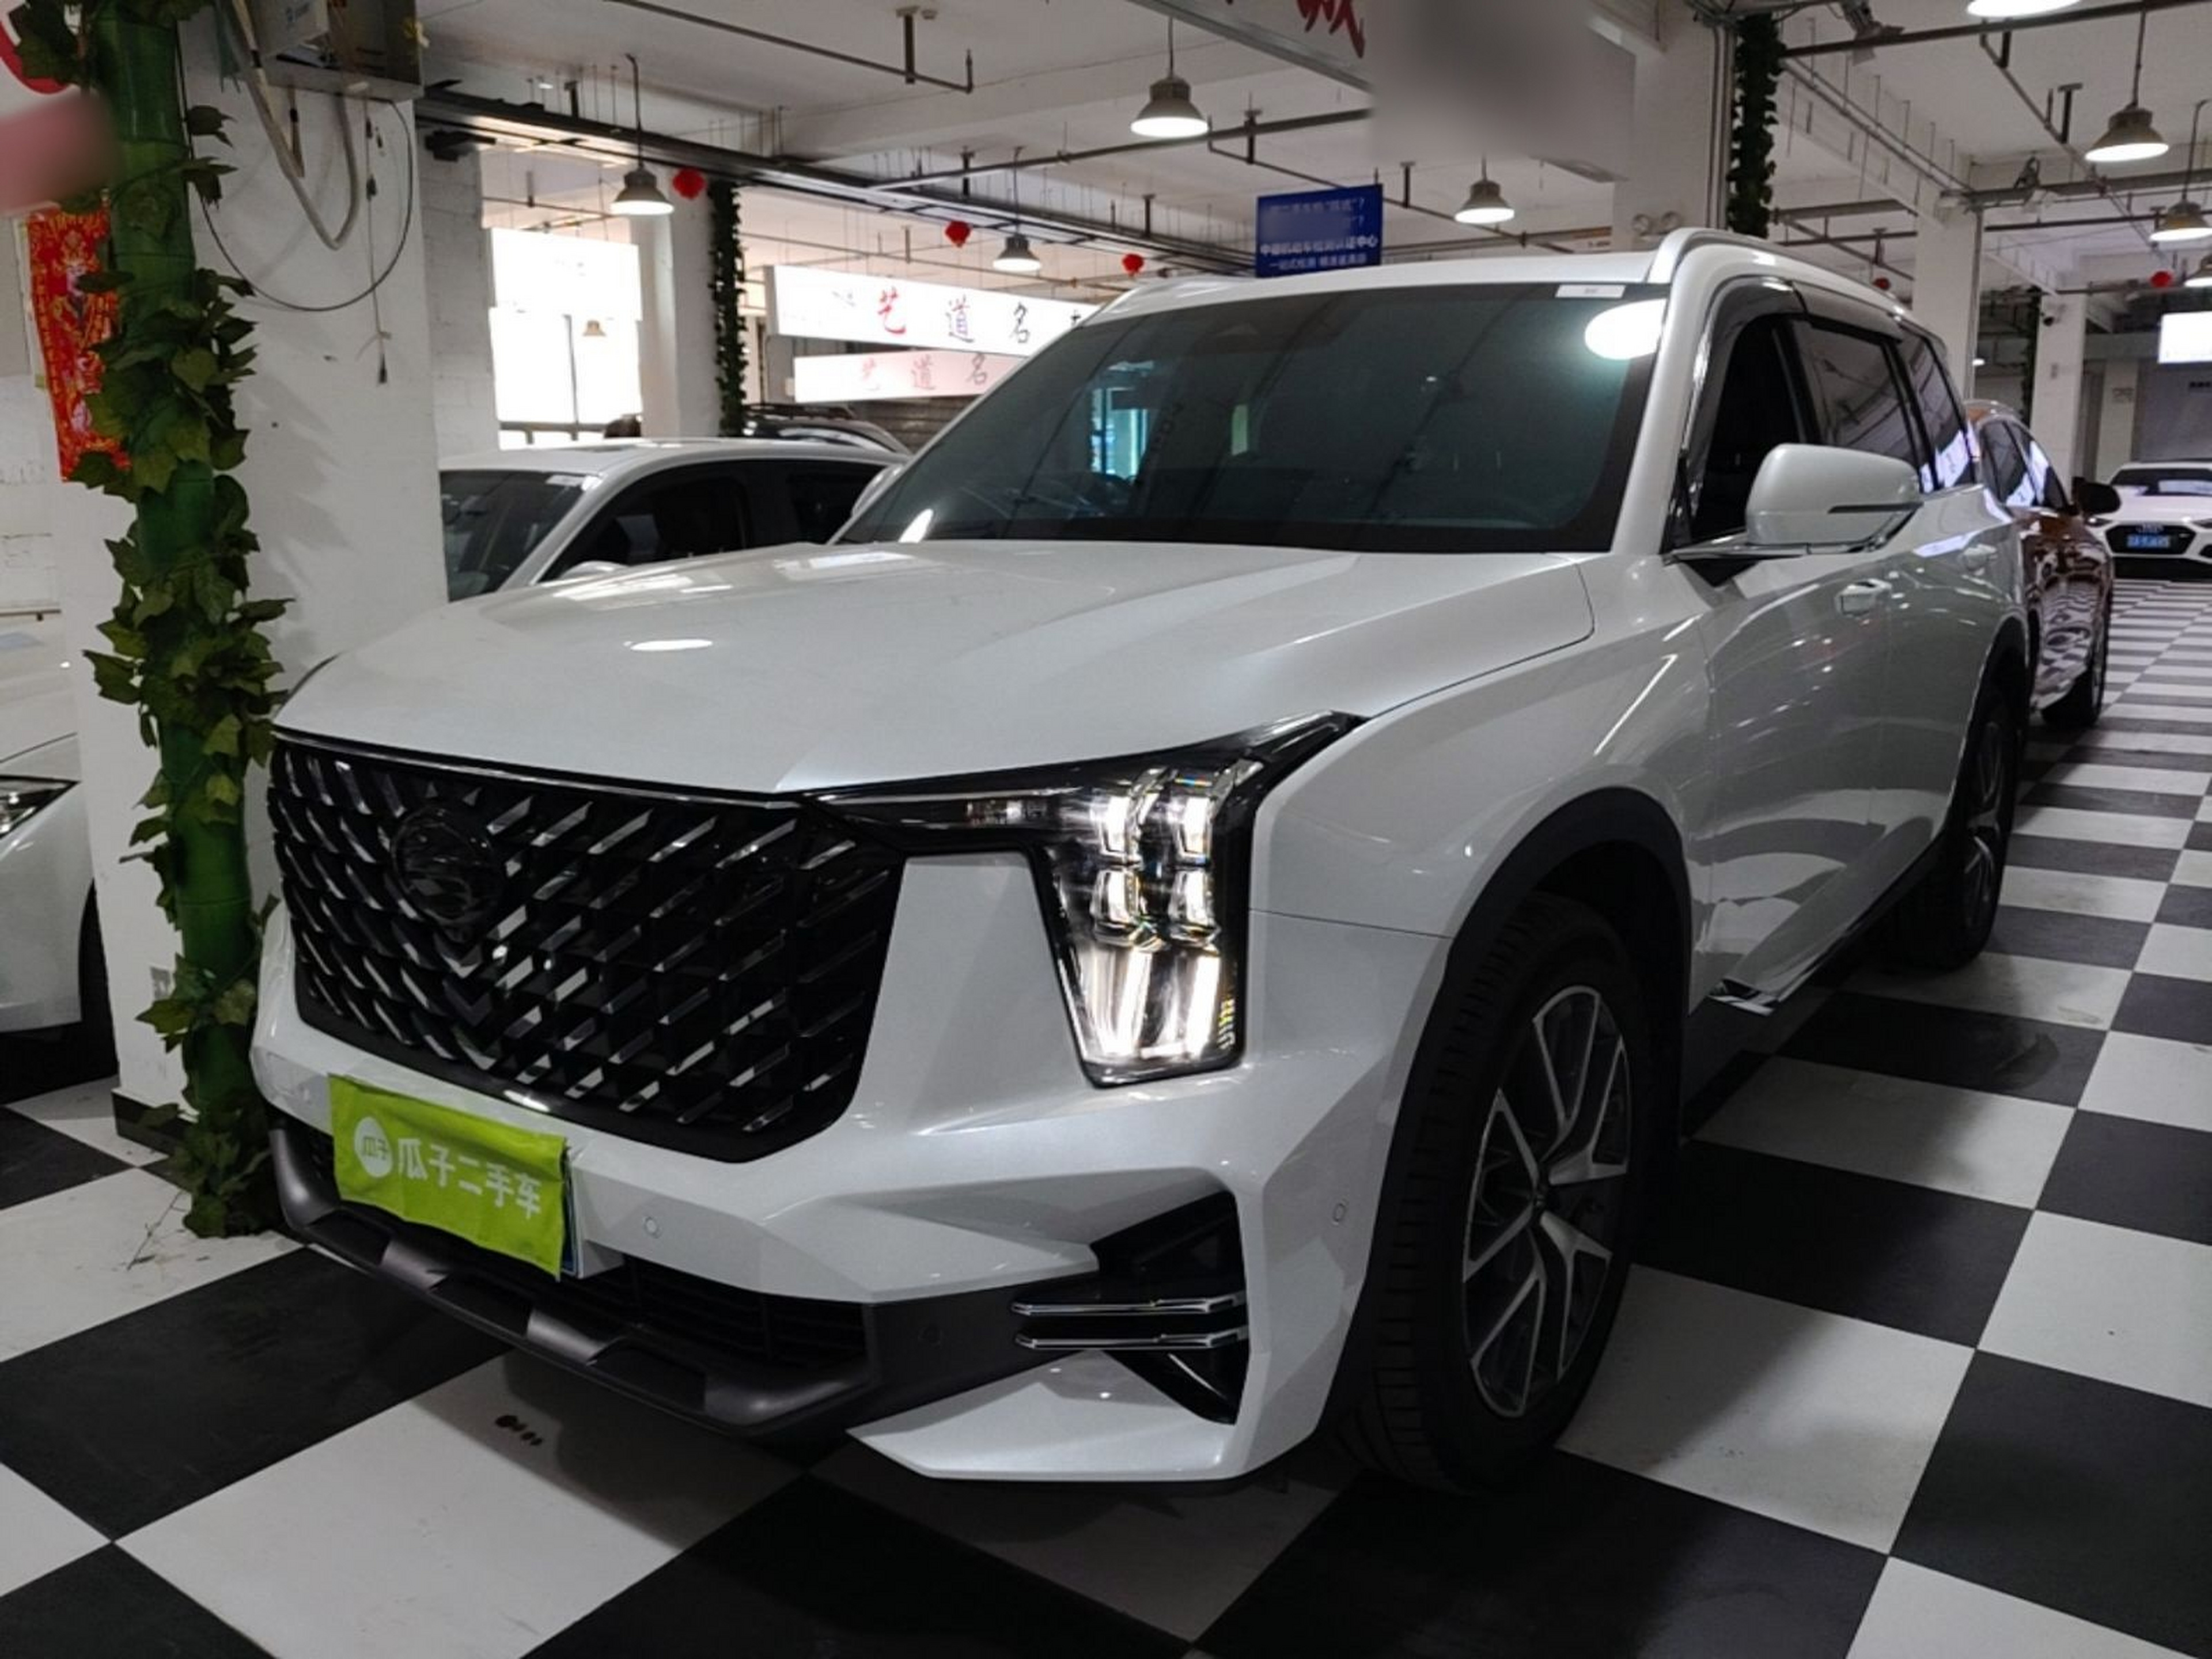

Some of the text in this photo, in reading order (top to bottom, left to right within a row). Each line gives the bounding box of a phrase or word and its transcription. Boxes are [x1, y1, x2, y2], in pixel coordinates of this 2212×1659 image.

[397, 1137, 541, 1220] 瓜子二手车
